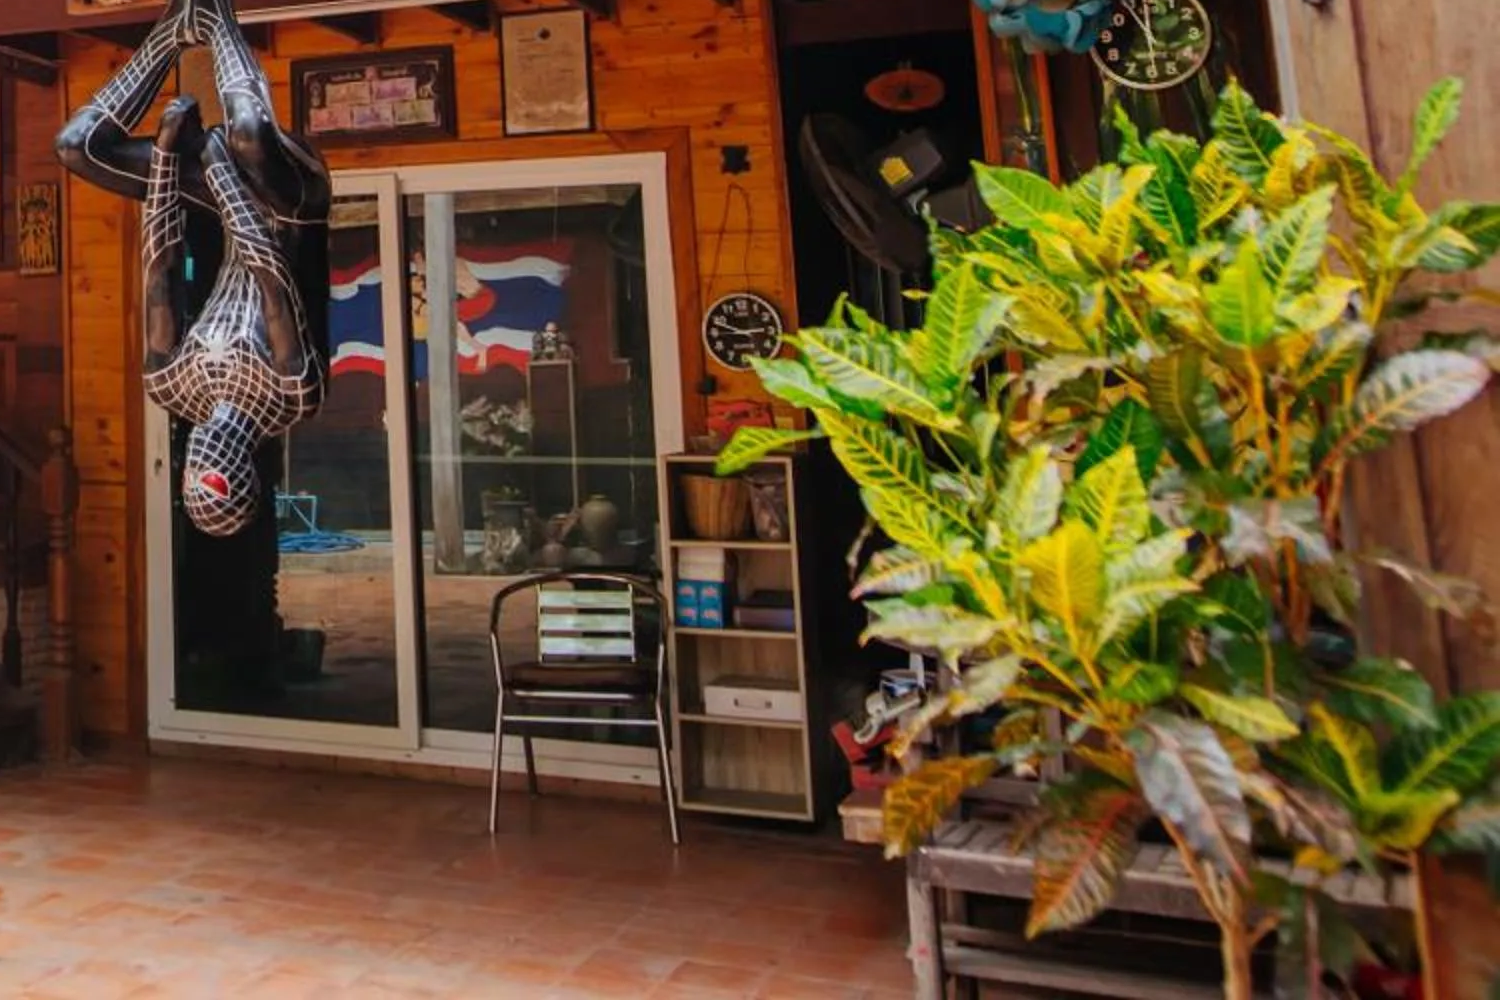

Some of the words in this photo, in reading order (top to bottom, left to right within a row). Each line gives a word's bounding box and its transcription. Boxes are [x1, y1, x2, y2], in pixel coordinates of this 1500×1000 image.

[1181, 7, 1193, 20] 2
[1101, 29, 1113, 43] 9
[1188, 27, 1200, 40] 3
[1108, 48, 1119, 61] 8
[1146, 64, 1158, 78] 6
[1165, 61, 1177, 75] 5
